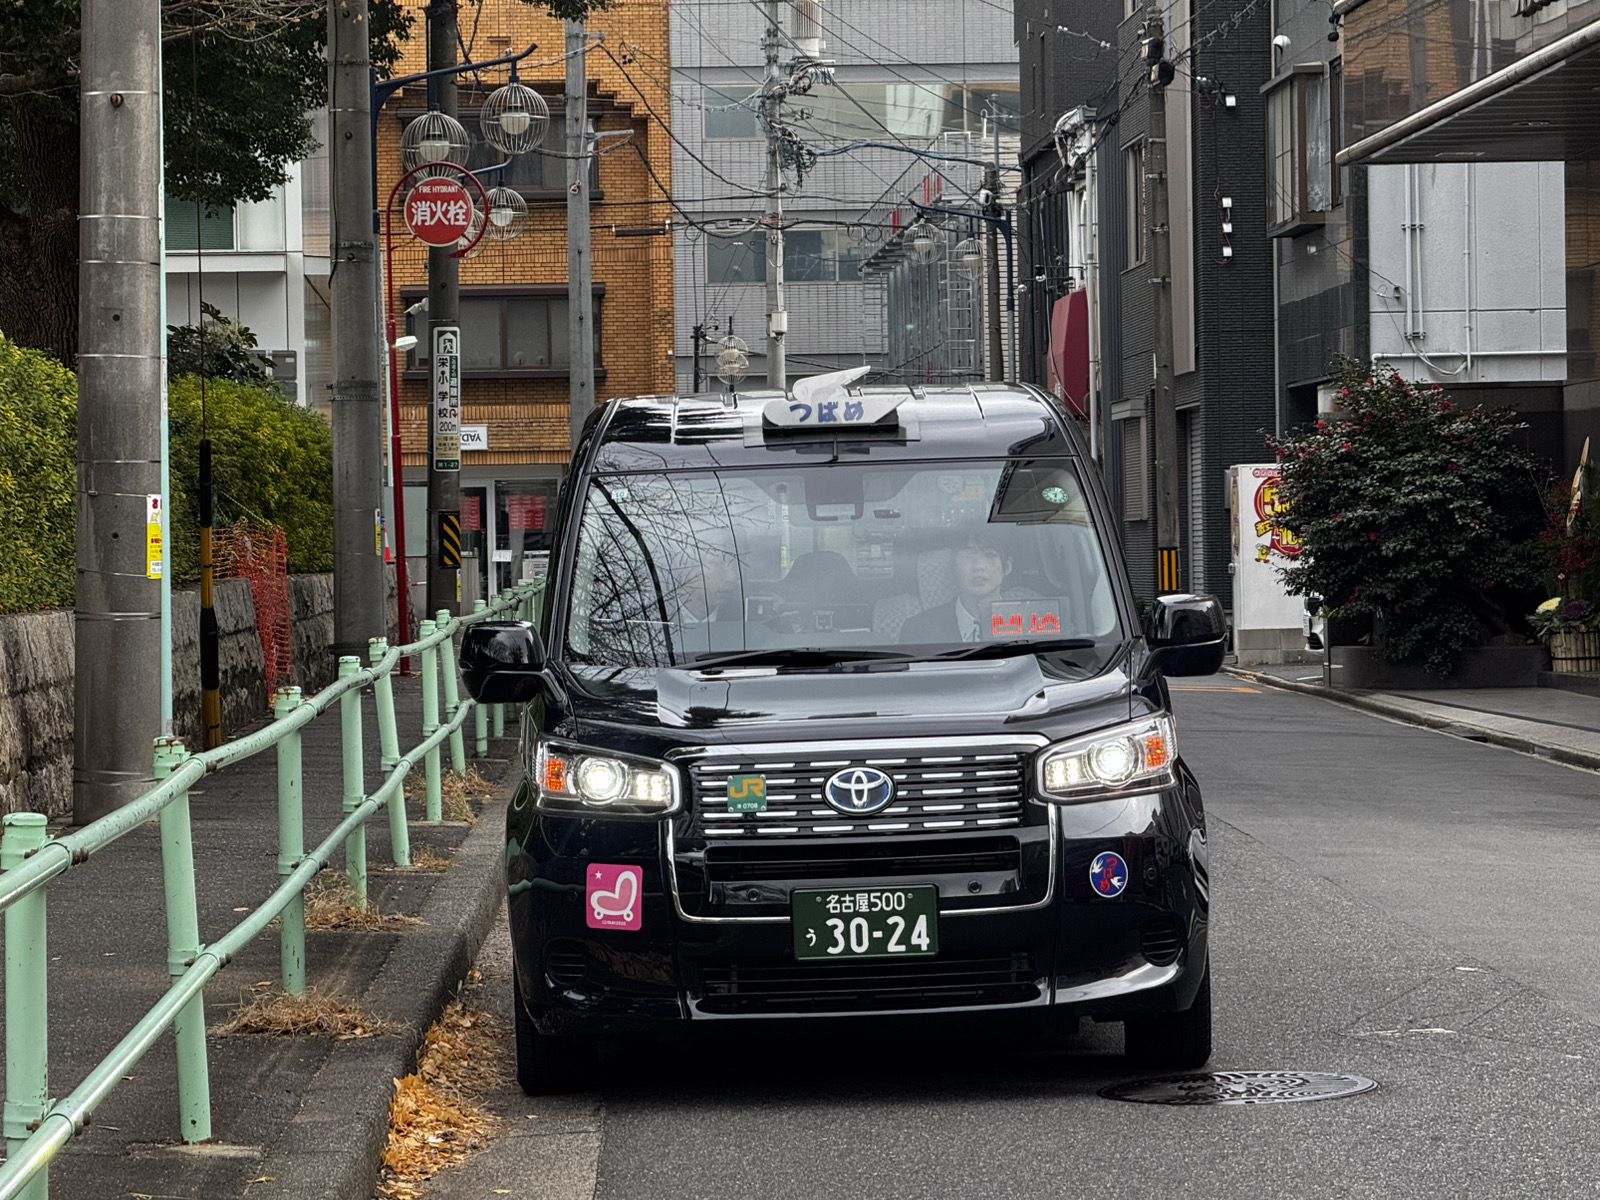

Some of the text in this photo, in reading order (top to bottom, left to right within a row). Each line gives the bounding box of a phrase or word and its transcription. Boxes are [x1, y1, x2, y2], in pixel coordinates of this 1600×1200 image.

[418, 185, 459, 193] FIRE HYDRANT
[411, 200, 468, 226] 消火栓
[437, 357, 449, 419] 栄小学校
[789, 401, 864, 423] つばめ
[439, 421, 457, 432] 200m
[730, 778, 764, 798] JR
[805, 914, 930, 955] う 30-24
